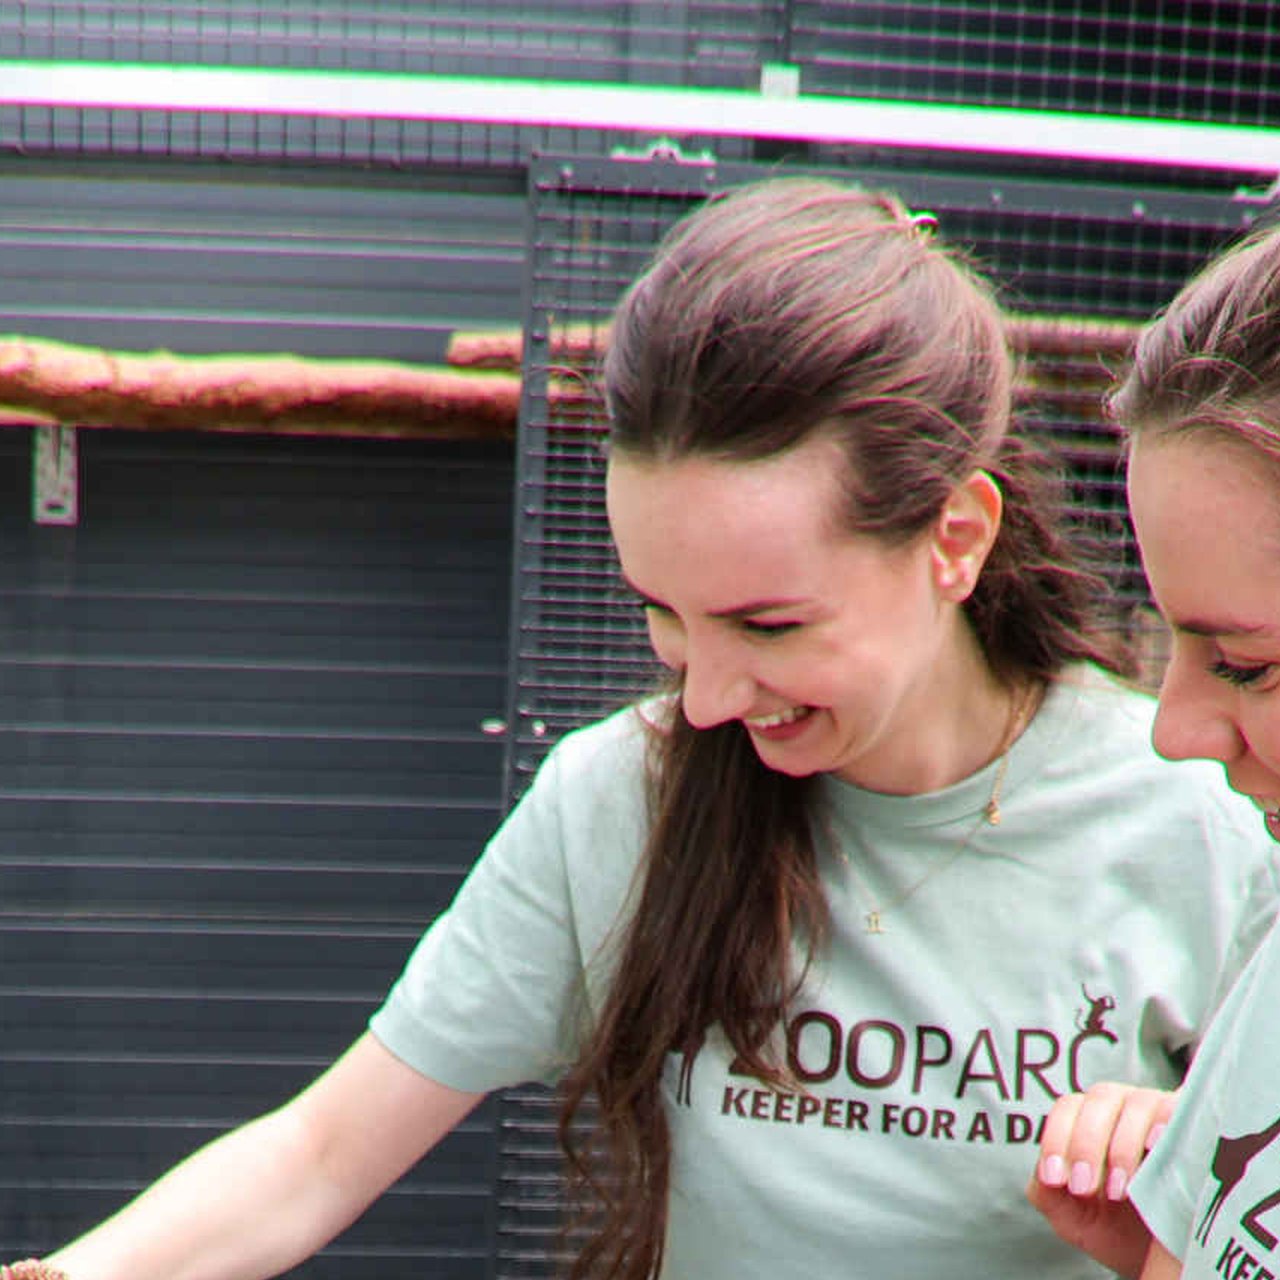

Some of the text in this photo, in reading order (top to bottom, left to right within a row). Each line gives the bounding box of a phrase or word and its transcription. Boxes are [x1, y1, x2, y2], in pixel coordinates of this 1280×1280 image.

[728, 1009, 1119, 1102] OOPARC
[720, 1085, 869, 1133] KEEPER
[881, 1102, 956, 1142] FOR
[965, 1111, 994, 1143] A
